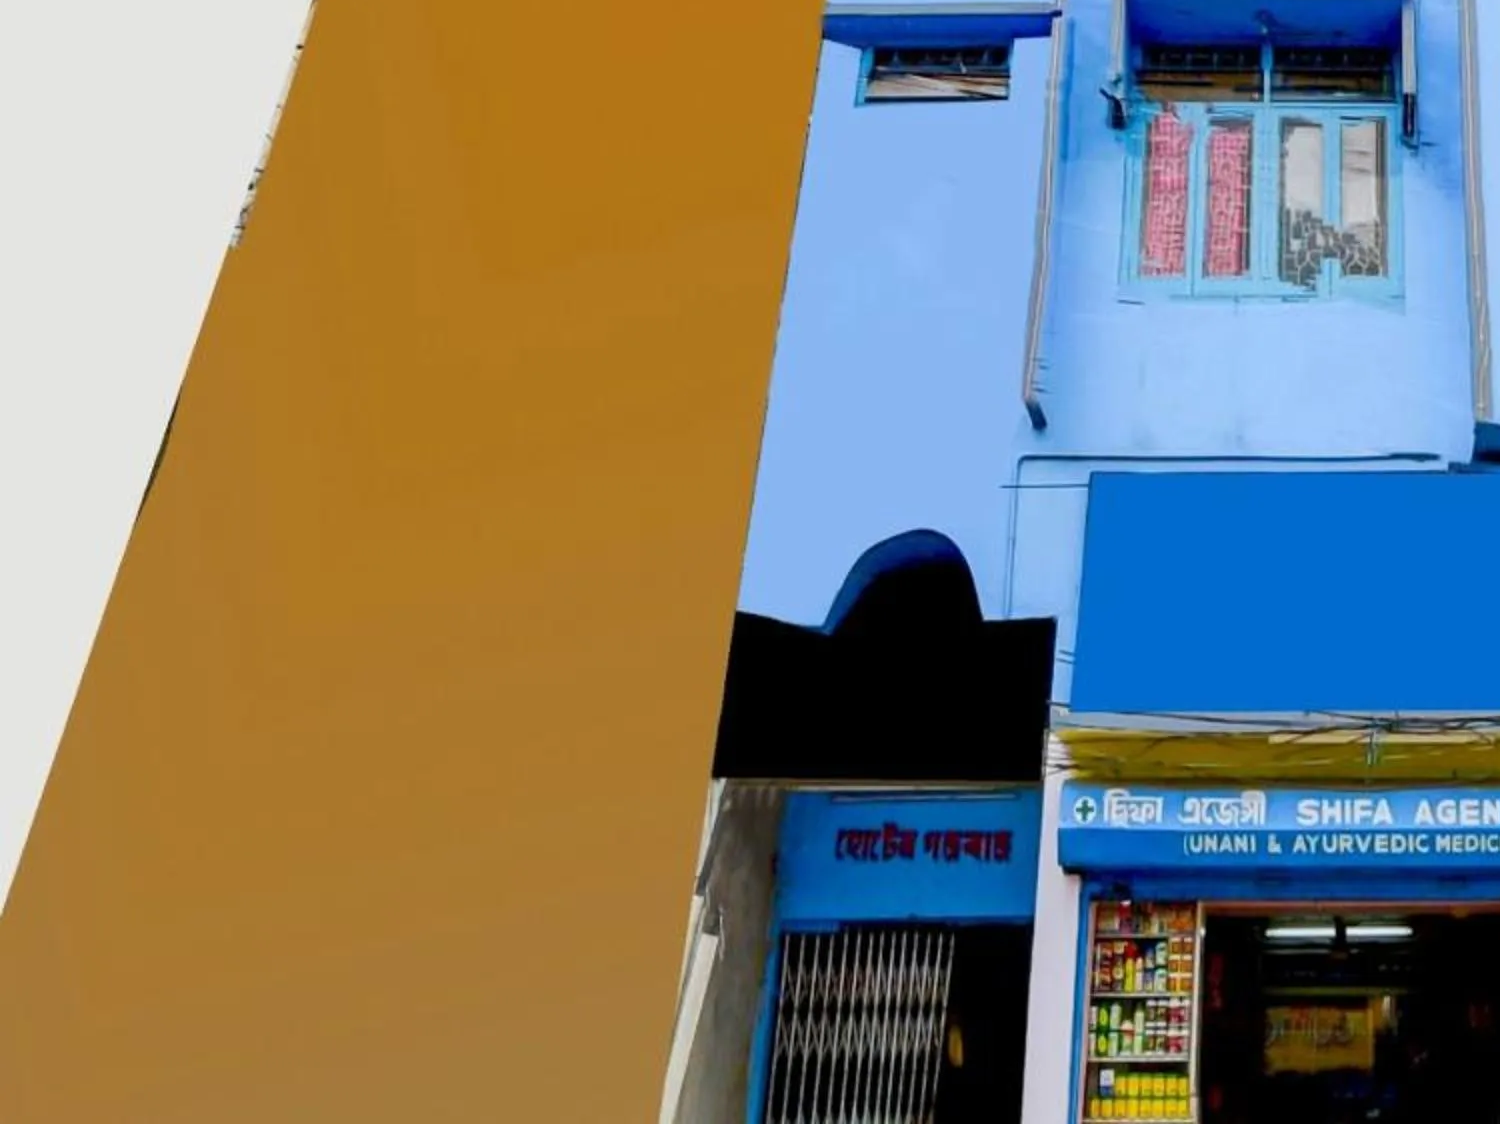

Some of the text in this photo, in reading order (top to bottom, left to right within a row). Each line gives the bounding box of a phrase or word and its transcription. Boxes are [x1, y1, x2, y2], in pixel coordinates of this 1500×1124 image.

[1296, 798, 1394, 826] SHIFA
[1268, 834, 1282, 854] &
[1294, 833, 1431, 854] AYURVEDIC
